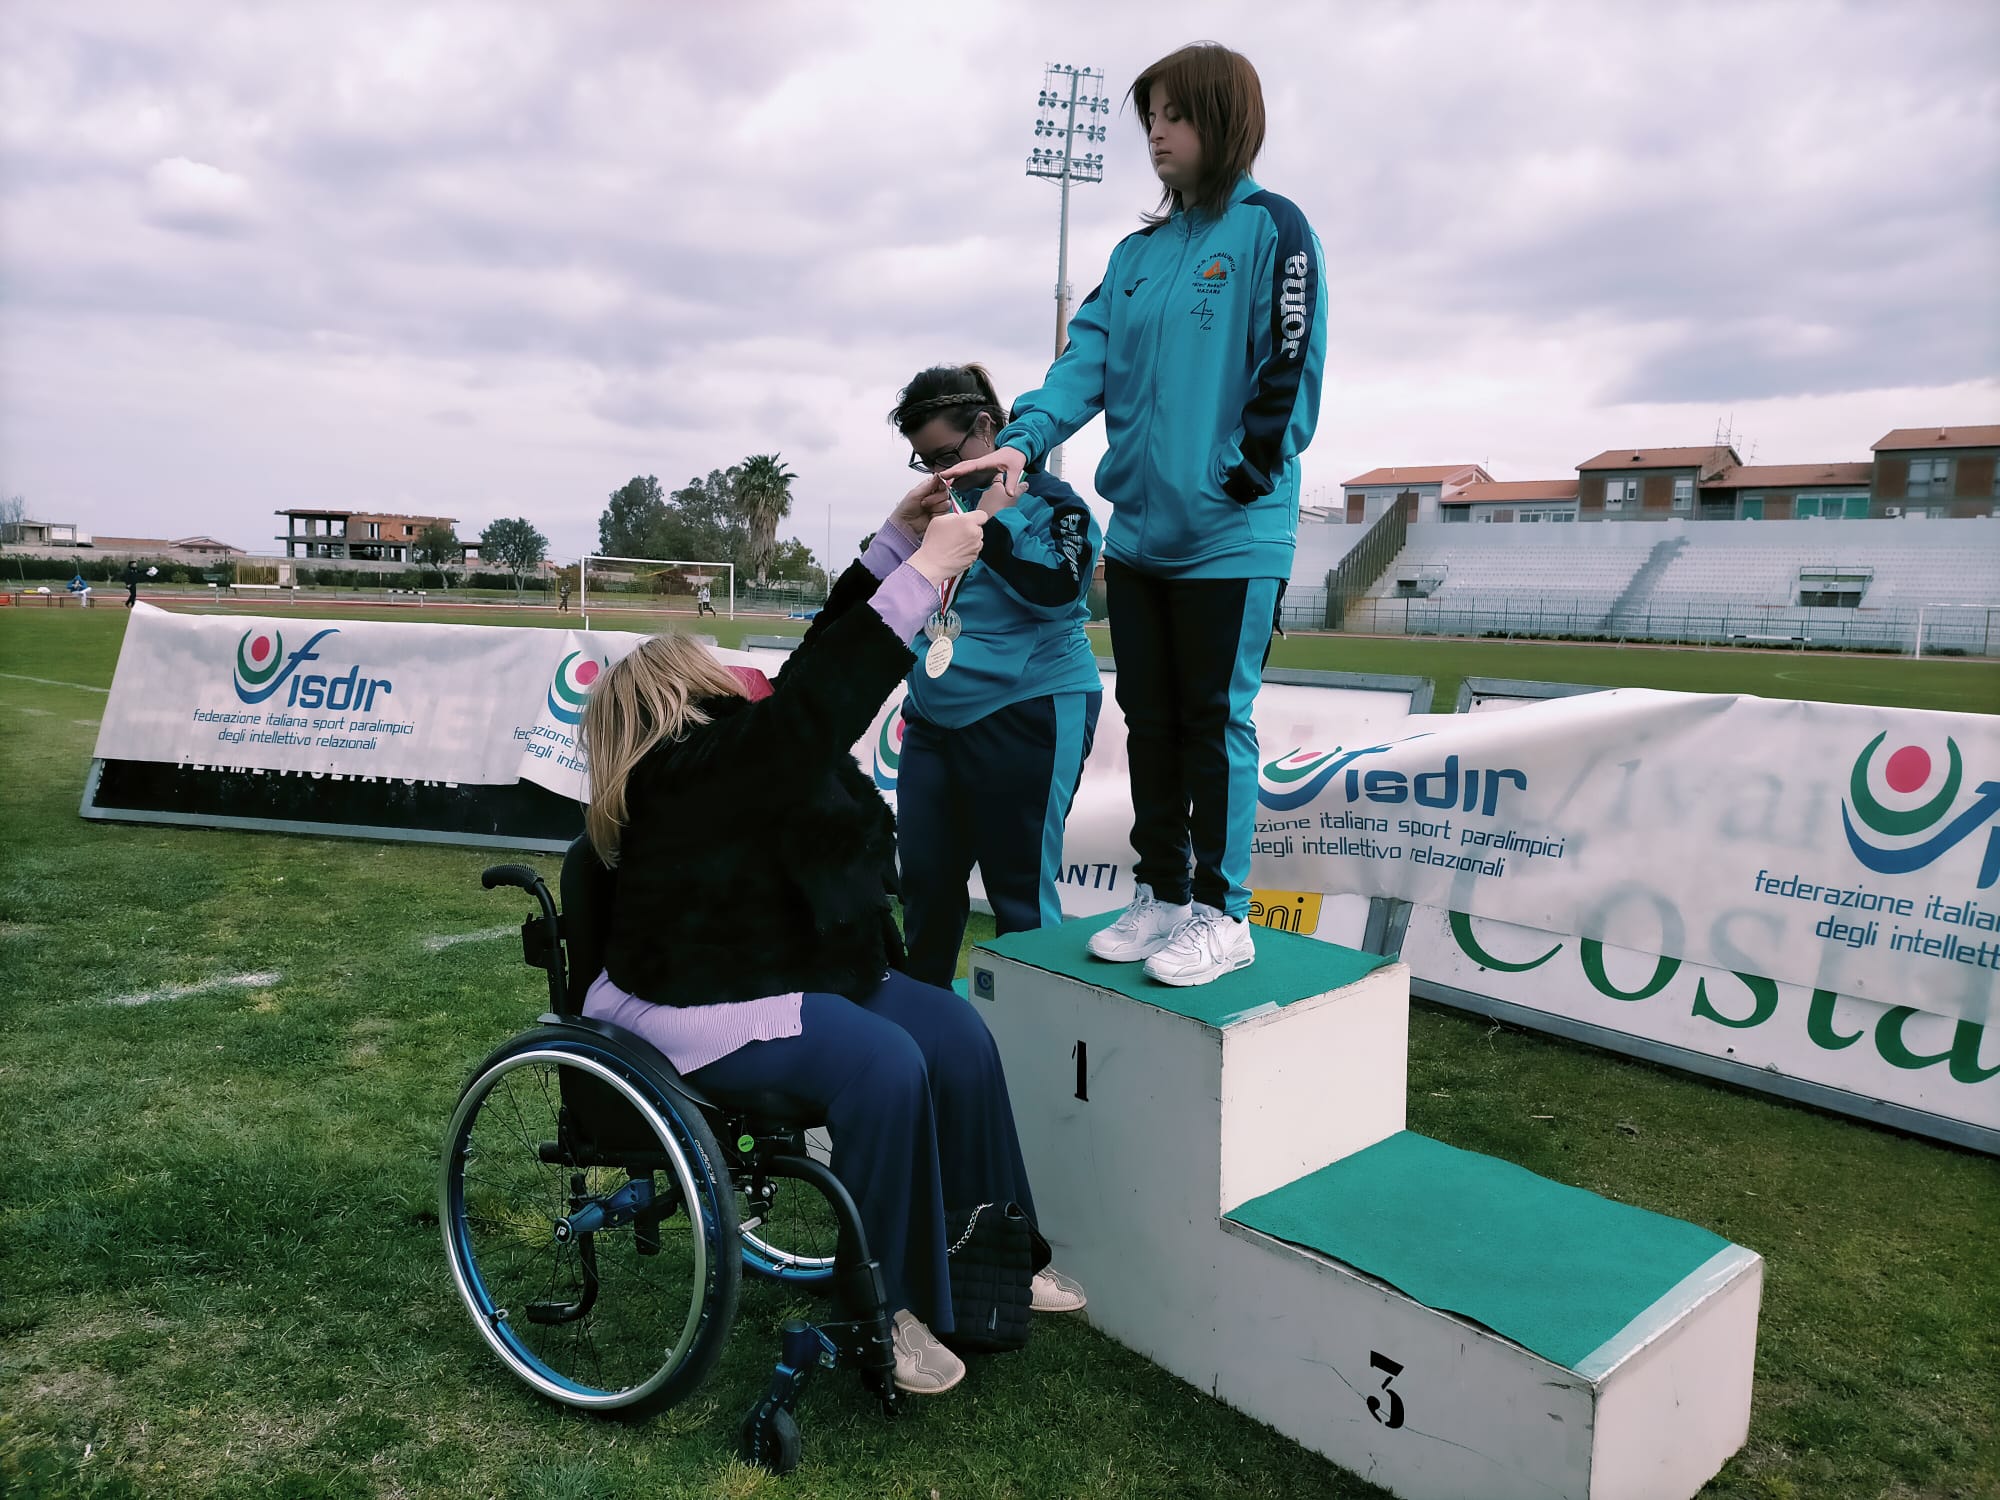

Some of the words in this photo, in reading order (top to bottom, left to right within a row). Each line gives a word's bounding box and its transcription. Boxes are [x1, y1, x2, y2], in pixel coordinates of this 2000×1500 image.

[1279, 251, 1308, 359] Joma
[250, 629, 392, 712] fisdir
[193, 708, 261, 725] federazione
[266, 712, 308, 728] italiana
[312, 716, 345, 731] sport
[349, 720, 415, 735] paralimpici
[218, 728, 245, 744] degli
[249, 729, 311, 746] intellettivo
[315, 736, 378, 750] relazionali
[1280, 732, 1528, 816] fisdir
[1250, 835, 1294, 858] degli
[1302, 837, 1402, 859] intellettivo
[1410, 848, 1506, 878] relazionali
[1319, 811, 1388, 832] italiana
[1398, 820, 1452, 840] sport
[1461, 828, 1565, 859] paralimpici
[1754, 870, 1914, 917] federazione
[1815, 915, 1880, 949] degli
[1071, 1039, 1089, 1102] 1
[1366, 1350, 1405, 1429] 3
